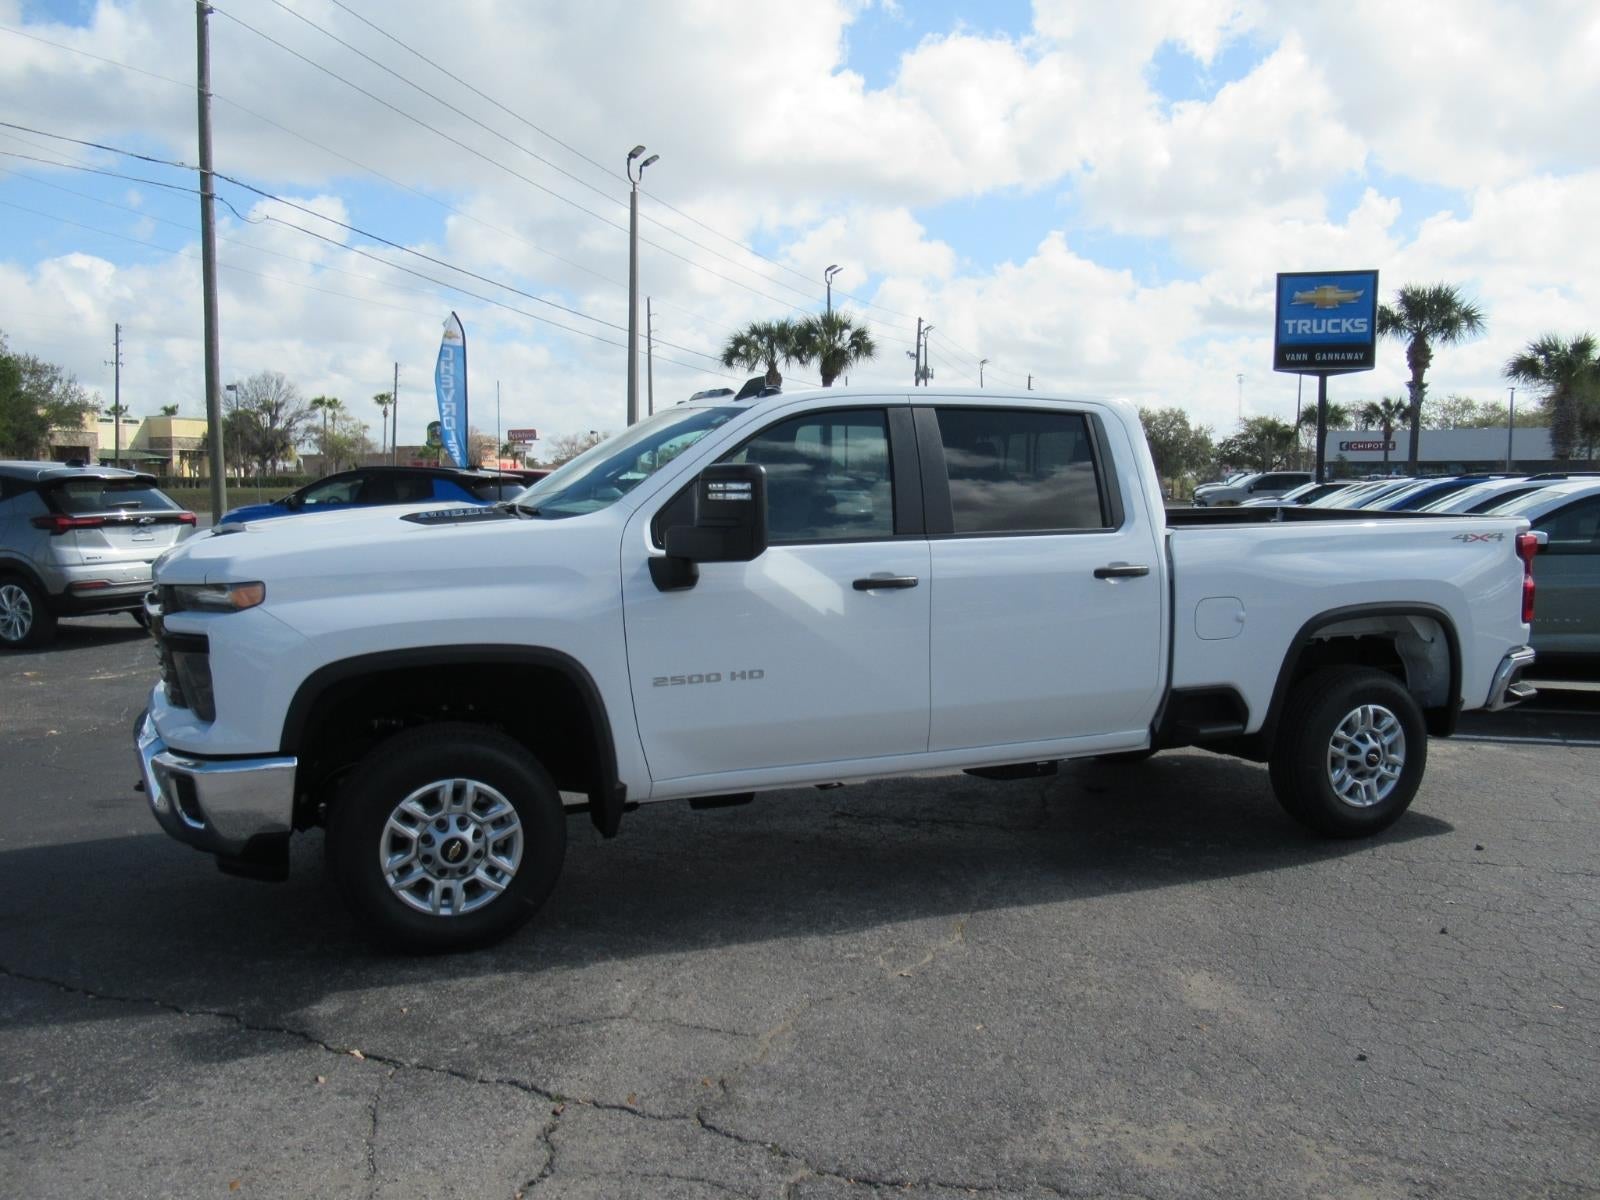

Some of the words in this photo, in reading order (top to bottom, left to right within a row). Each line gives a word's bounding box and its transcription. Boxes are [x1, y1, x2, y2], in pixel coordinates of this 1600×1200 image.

[1284, 319, 1368, 334] TRUCKS
[1285, 353, 1308, 361] VANN
[1315, 352, 1364, 361] GANNAWAY
[652, 672, 722, 688] 2500
[730, 669, 765, 681] HD
